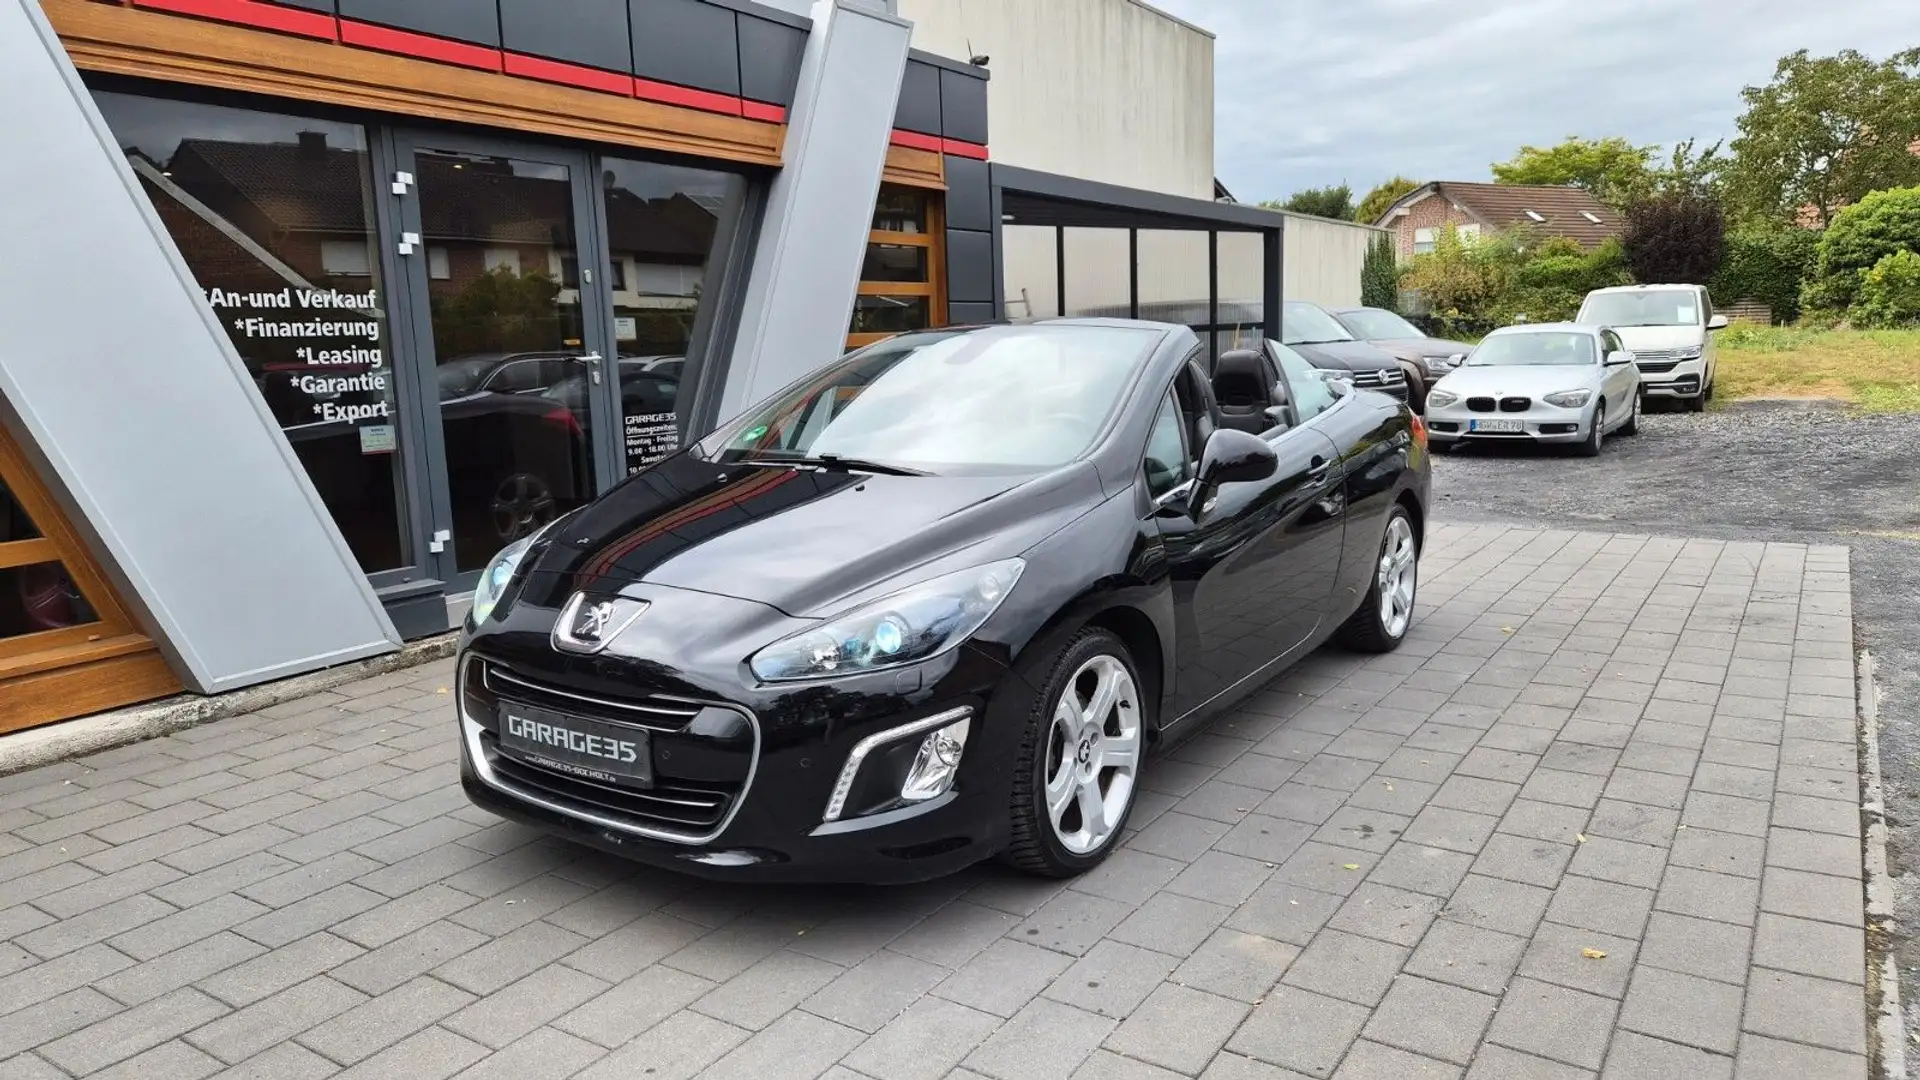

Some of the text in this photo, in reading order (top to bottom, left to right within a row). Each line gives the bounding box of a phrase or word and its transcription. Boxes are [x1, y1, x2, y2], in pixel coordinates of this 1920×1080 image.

[296, 288, 376, 309] Verkauf
[625, 412, 677, 425] GARAGE35
[626, 437, 652, 446] Montag
[656, 434, 679, 443] Freitag
[667, 443, 679, 451] Uhr
[507, 715, 637, 763] GARAGE35
